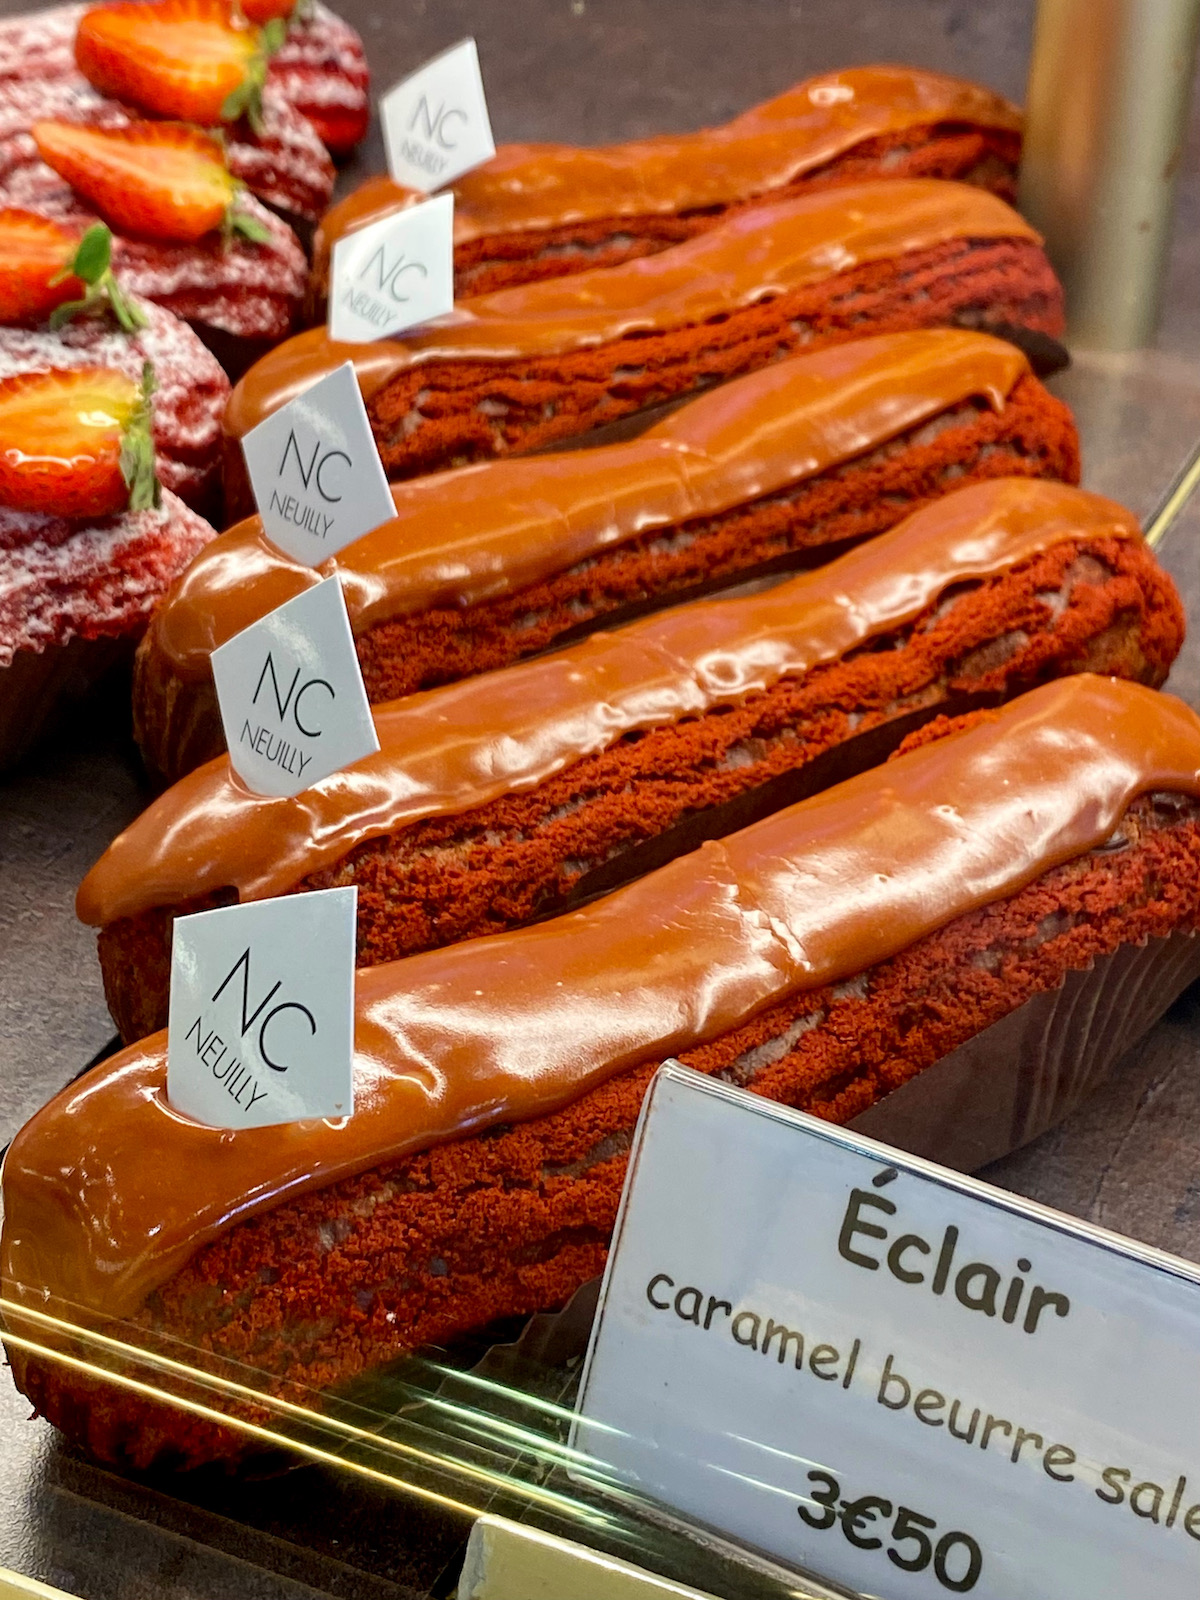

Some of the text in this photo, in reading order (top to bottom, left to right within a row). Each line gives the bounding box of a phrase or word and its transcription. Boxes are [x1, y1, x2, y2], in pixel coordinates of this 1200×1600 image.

[408, 94, 468, 149] NC
[342, 287, 397, 327] NEUILLY
[360, 243, 428, 302] NC
[279, 428, 352, 502] NC
[269, 489, 335, 539] NEUILLY
[253, 652, 336, 738] NC
[240, 719, 313, 779] NEUILLY
[211, 946, 317, 1073] NC
[185, 1015, 268, 1112] NEUILLY
[837, 1167, 1070, 1334] Éclair
[646, 1273, 861, 1389] caramel
[877, 1354, 1075, 1483] beurre
[797, 1470, 983, 1593] 3€50
